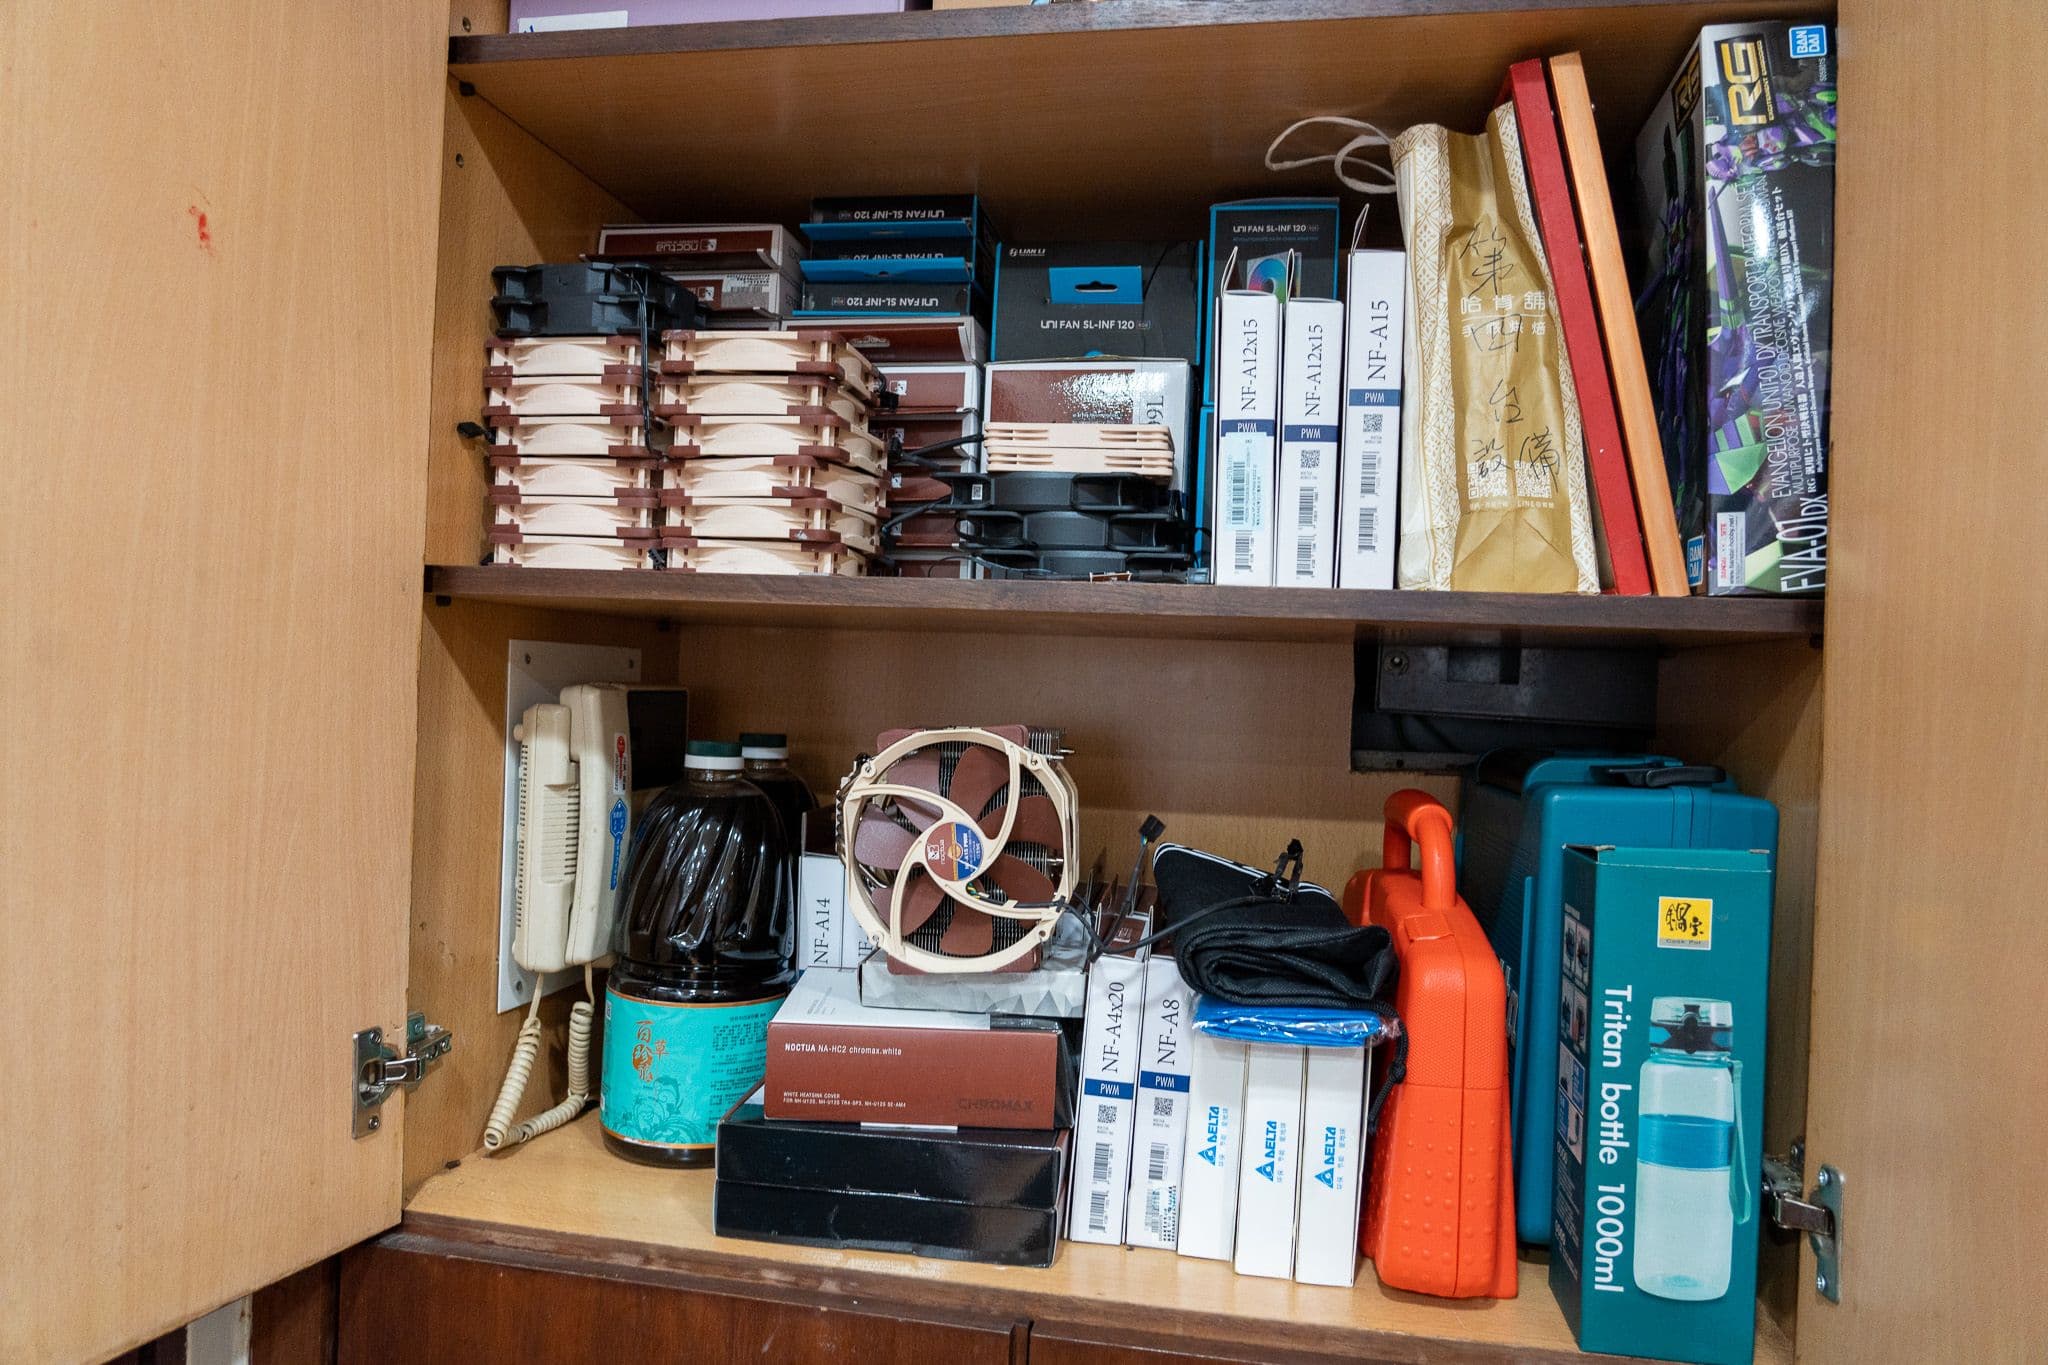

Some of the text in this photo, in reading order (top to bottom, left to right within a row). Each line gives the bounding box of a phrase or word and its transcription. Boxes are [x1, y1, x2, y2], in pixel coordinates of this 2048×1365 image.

[1721, 42, 1767, 125] RG
[853, 210, 870, 219] 120
[871, 210, 903, 219] SL-INF
[905, 210, 926, 218] FAN
[1247, 225, 1264, 233] FAN
[1266, 224, 1291, 232] SL-INF
[1293, 224, 1307, 232] 120
[847, 297, 863, 307] 120
[865, 297, 897, 307] SL-INF
[899, 298, 921, 307] FAN
[1059, 320, 1080, 329] FAN
[1083, 320, 1116, 330] SL-INF
[1118, 320, 1135, 330] 120
[1367, 300, 1389, 381] NF-A15
[1241, 319, 1258, 412] NF-A12x15
[1305, 324, 1324, 417] NF-A12x15
[1364, 393, 1385, 404] PWM
[1237, 422, 1257, 433] PWM
[1301, 428, 1321, 439] PWM
[1763, 414, 1792, 498] EVANGELION
[814, 897, 830, 964] NF-A14
[1101, 981, 1125, 1074] NF-A4x20
[1157, 999, 1180, 1066] NF-A8
[784, 1043, 902, 1056] NOCTUA NA-HC2 chromax.white
[1155, 1075, 1175, 1089] PWM
[1100, 1083, 1120, 1096] PWM
[1207, 1106, 1220, 1143] DELTA
[1264, 1120, 1277, 1159] DELTA
[1594, 984, 1632, 1292] Tritan bottle 1000ml
[1324, 1126, 1337, 1165] DELTA
